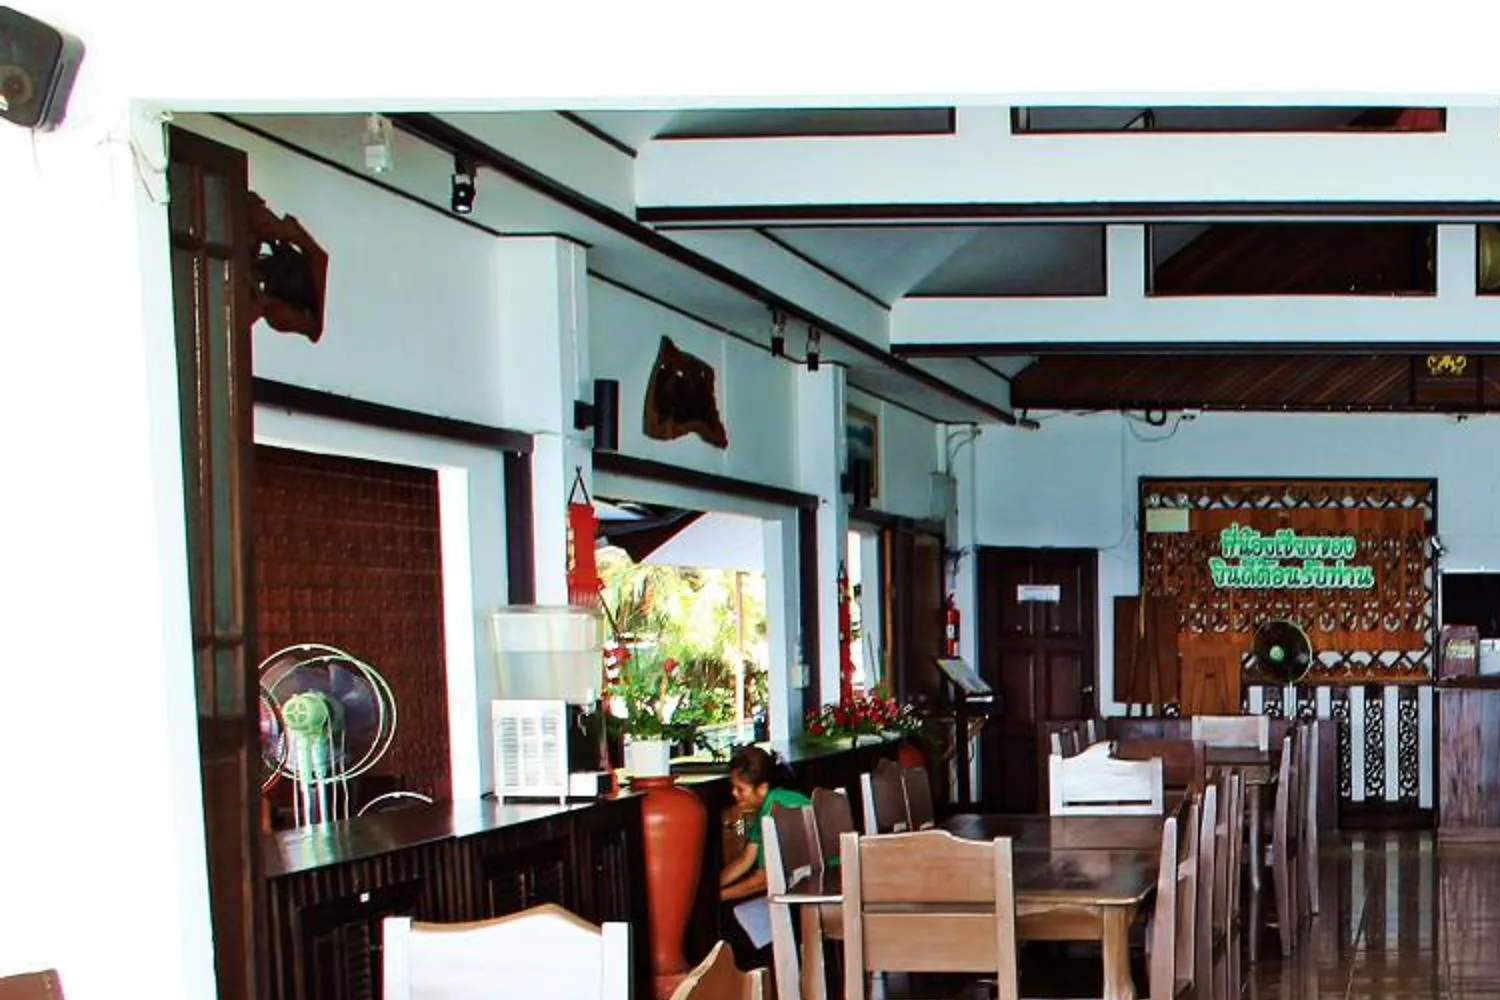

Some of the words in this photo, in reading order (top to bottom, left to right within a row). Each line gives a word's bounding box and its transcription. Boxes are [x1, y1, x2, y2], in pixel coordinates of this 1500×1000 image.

[1210, 557, 1375, 587] ยินดีต้อนรับท่าน
